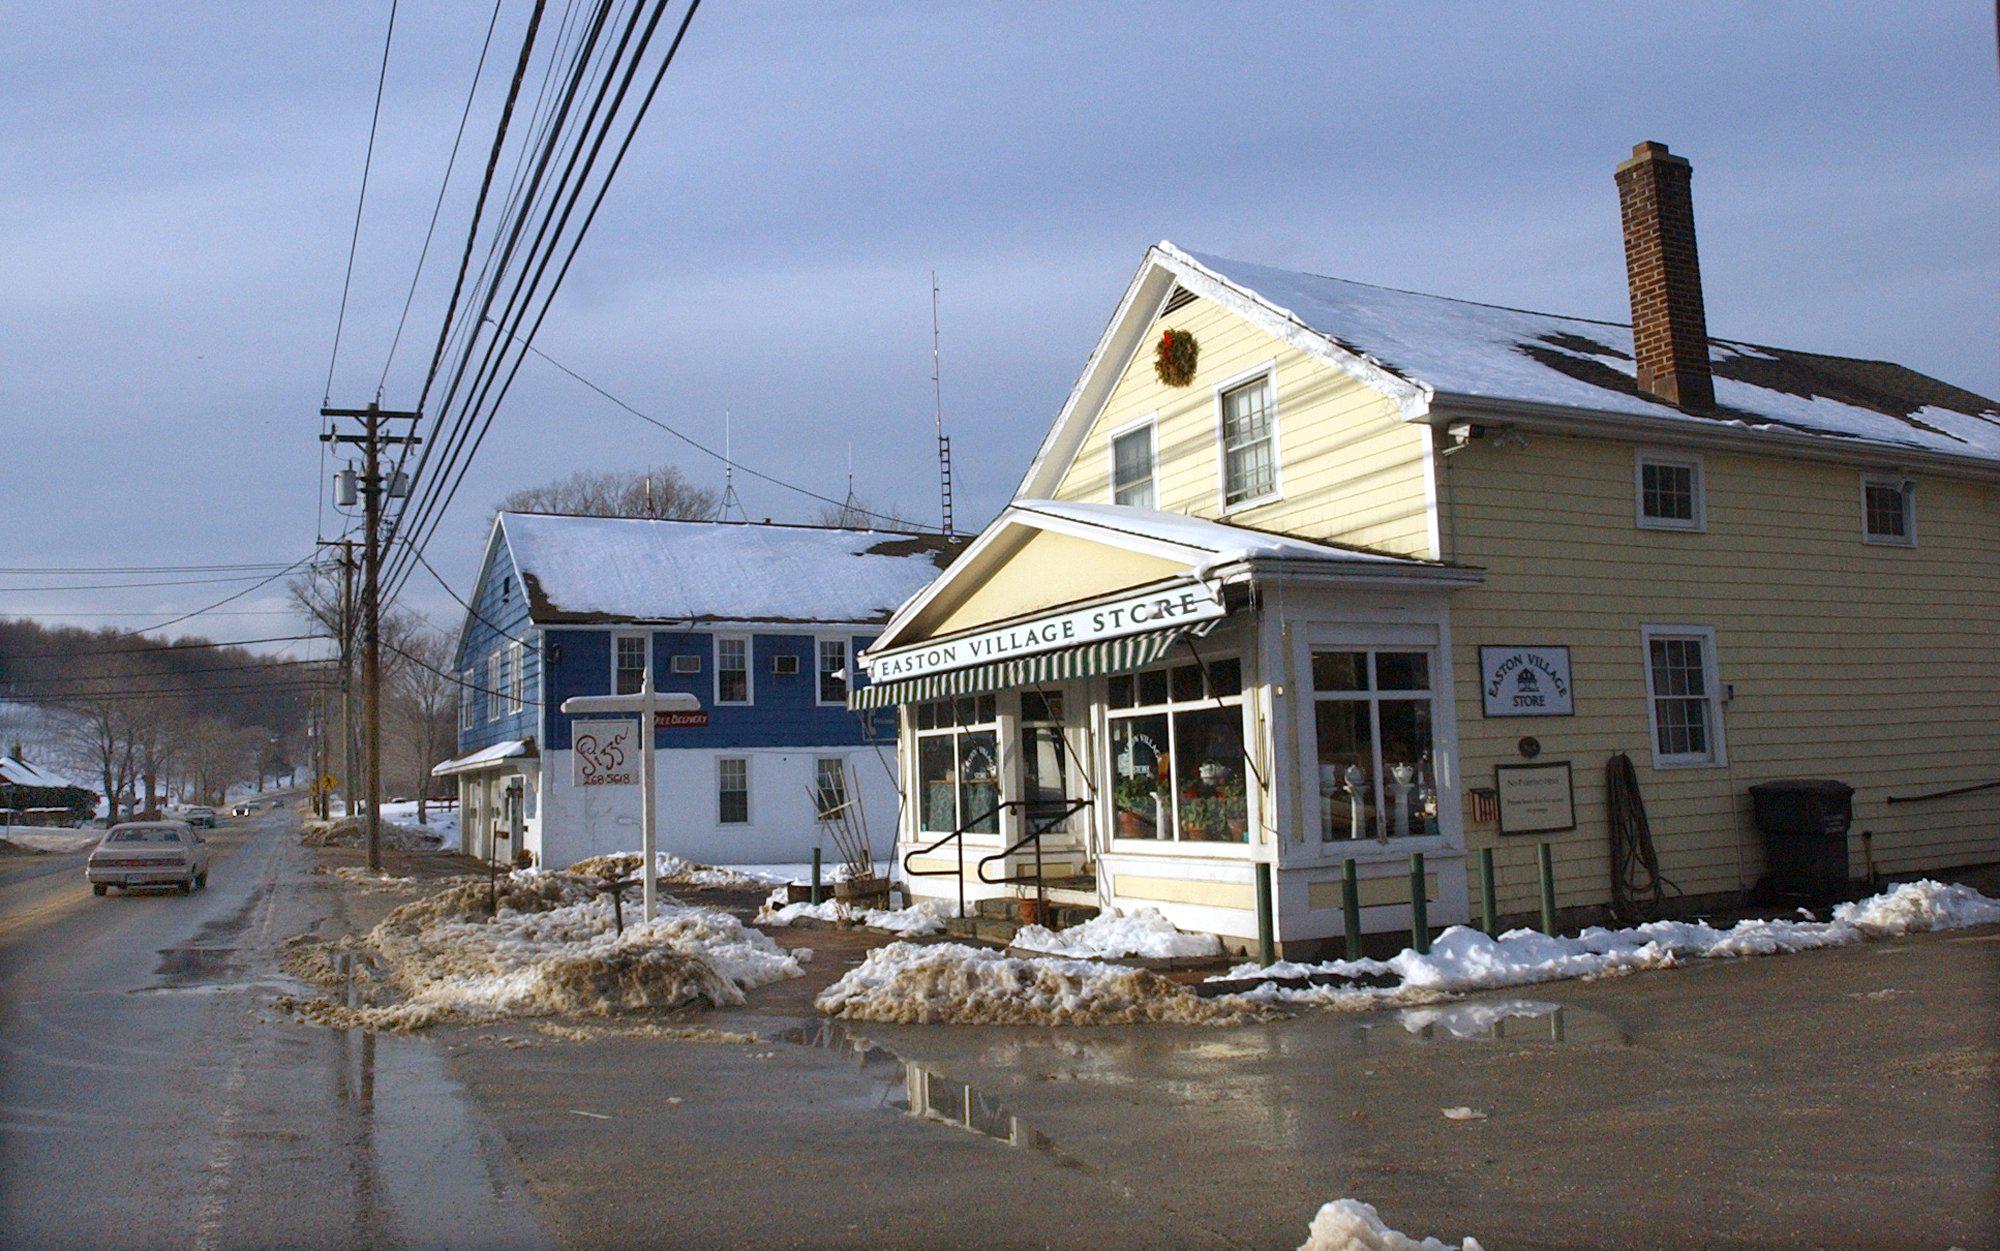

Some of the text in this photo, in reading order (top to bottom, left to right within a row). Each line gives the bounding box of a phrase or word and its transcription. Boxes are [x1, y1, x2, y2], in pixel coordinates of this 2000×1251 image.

[881, 645, 957, 678] EASTON
[969, 620, 1076, 657] VILLAGE
[1488, 653, 1567, 698] EASTON VILLAGE
[1513, 694, 1546, 707] STORE
[576, 726, 629, 776] Pizza
